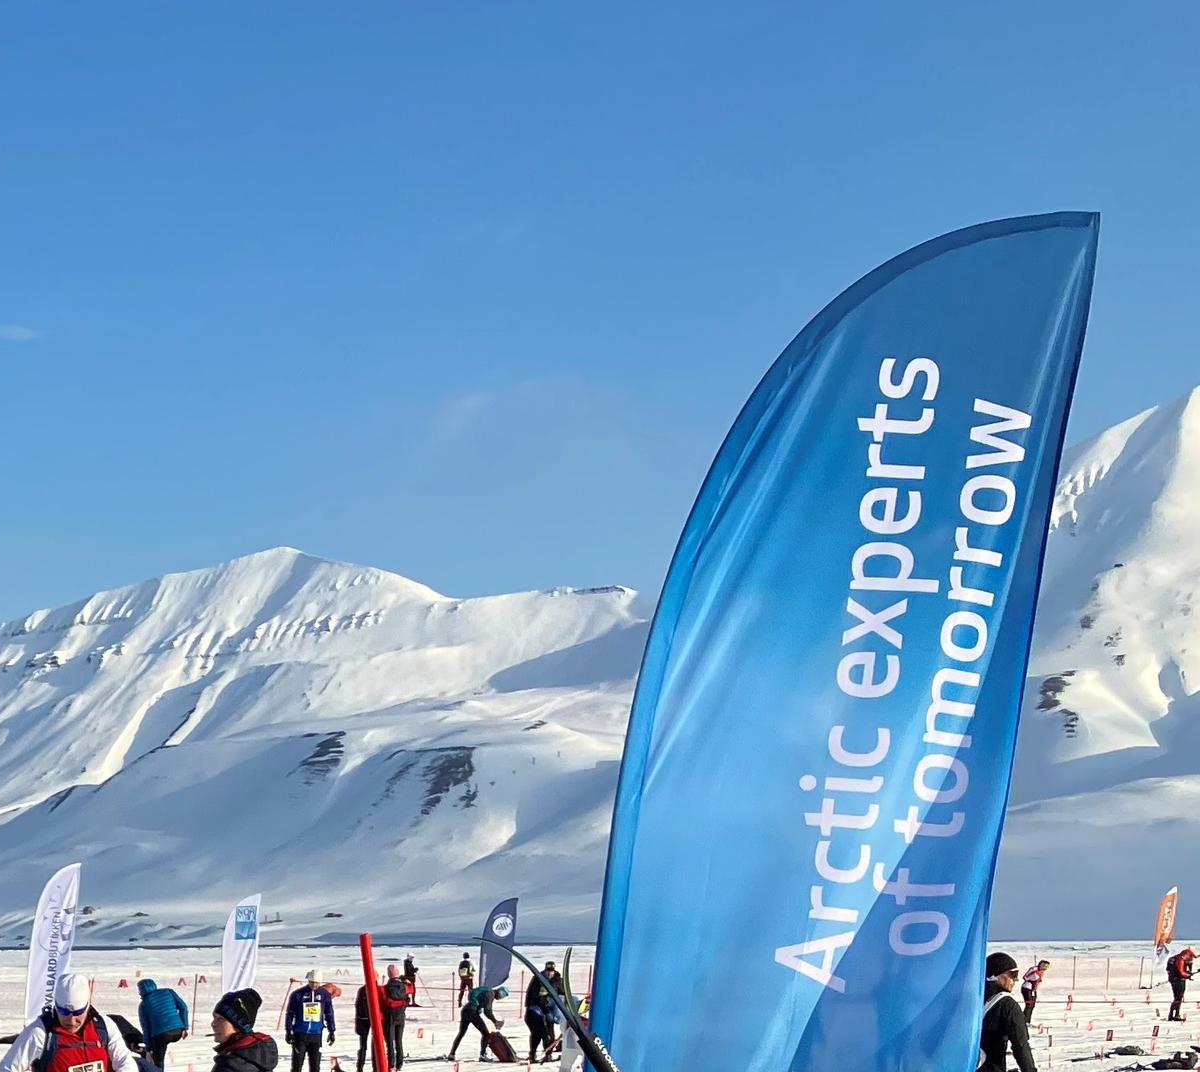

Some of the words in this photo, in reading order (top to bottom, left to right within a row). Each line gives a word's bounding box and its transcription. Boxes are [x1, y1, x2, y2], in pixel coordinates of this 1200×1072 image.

[775, 725, 891, 993] Arctic
[837, 357, 940, 698] experts
[894, 398, 1032, 843] tomorrow
[44, 911, 62, 1011] VALBARDBUTIKKEN
[873, 863, 955, 957] of
